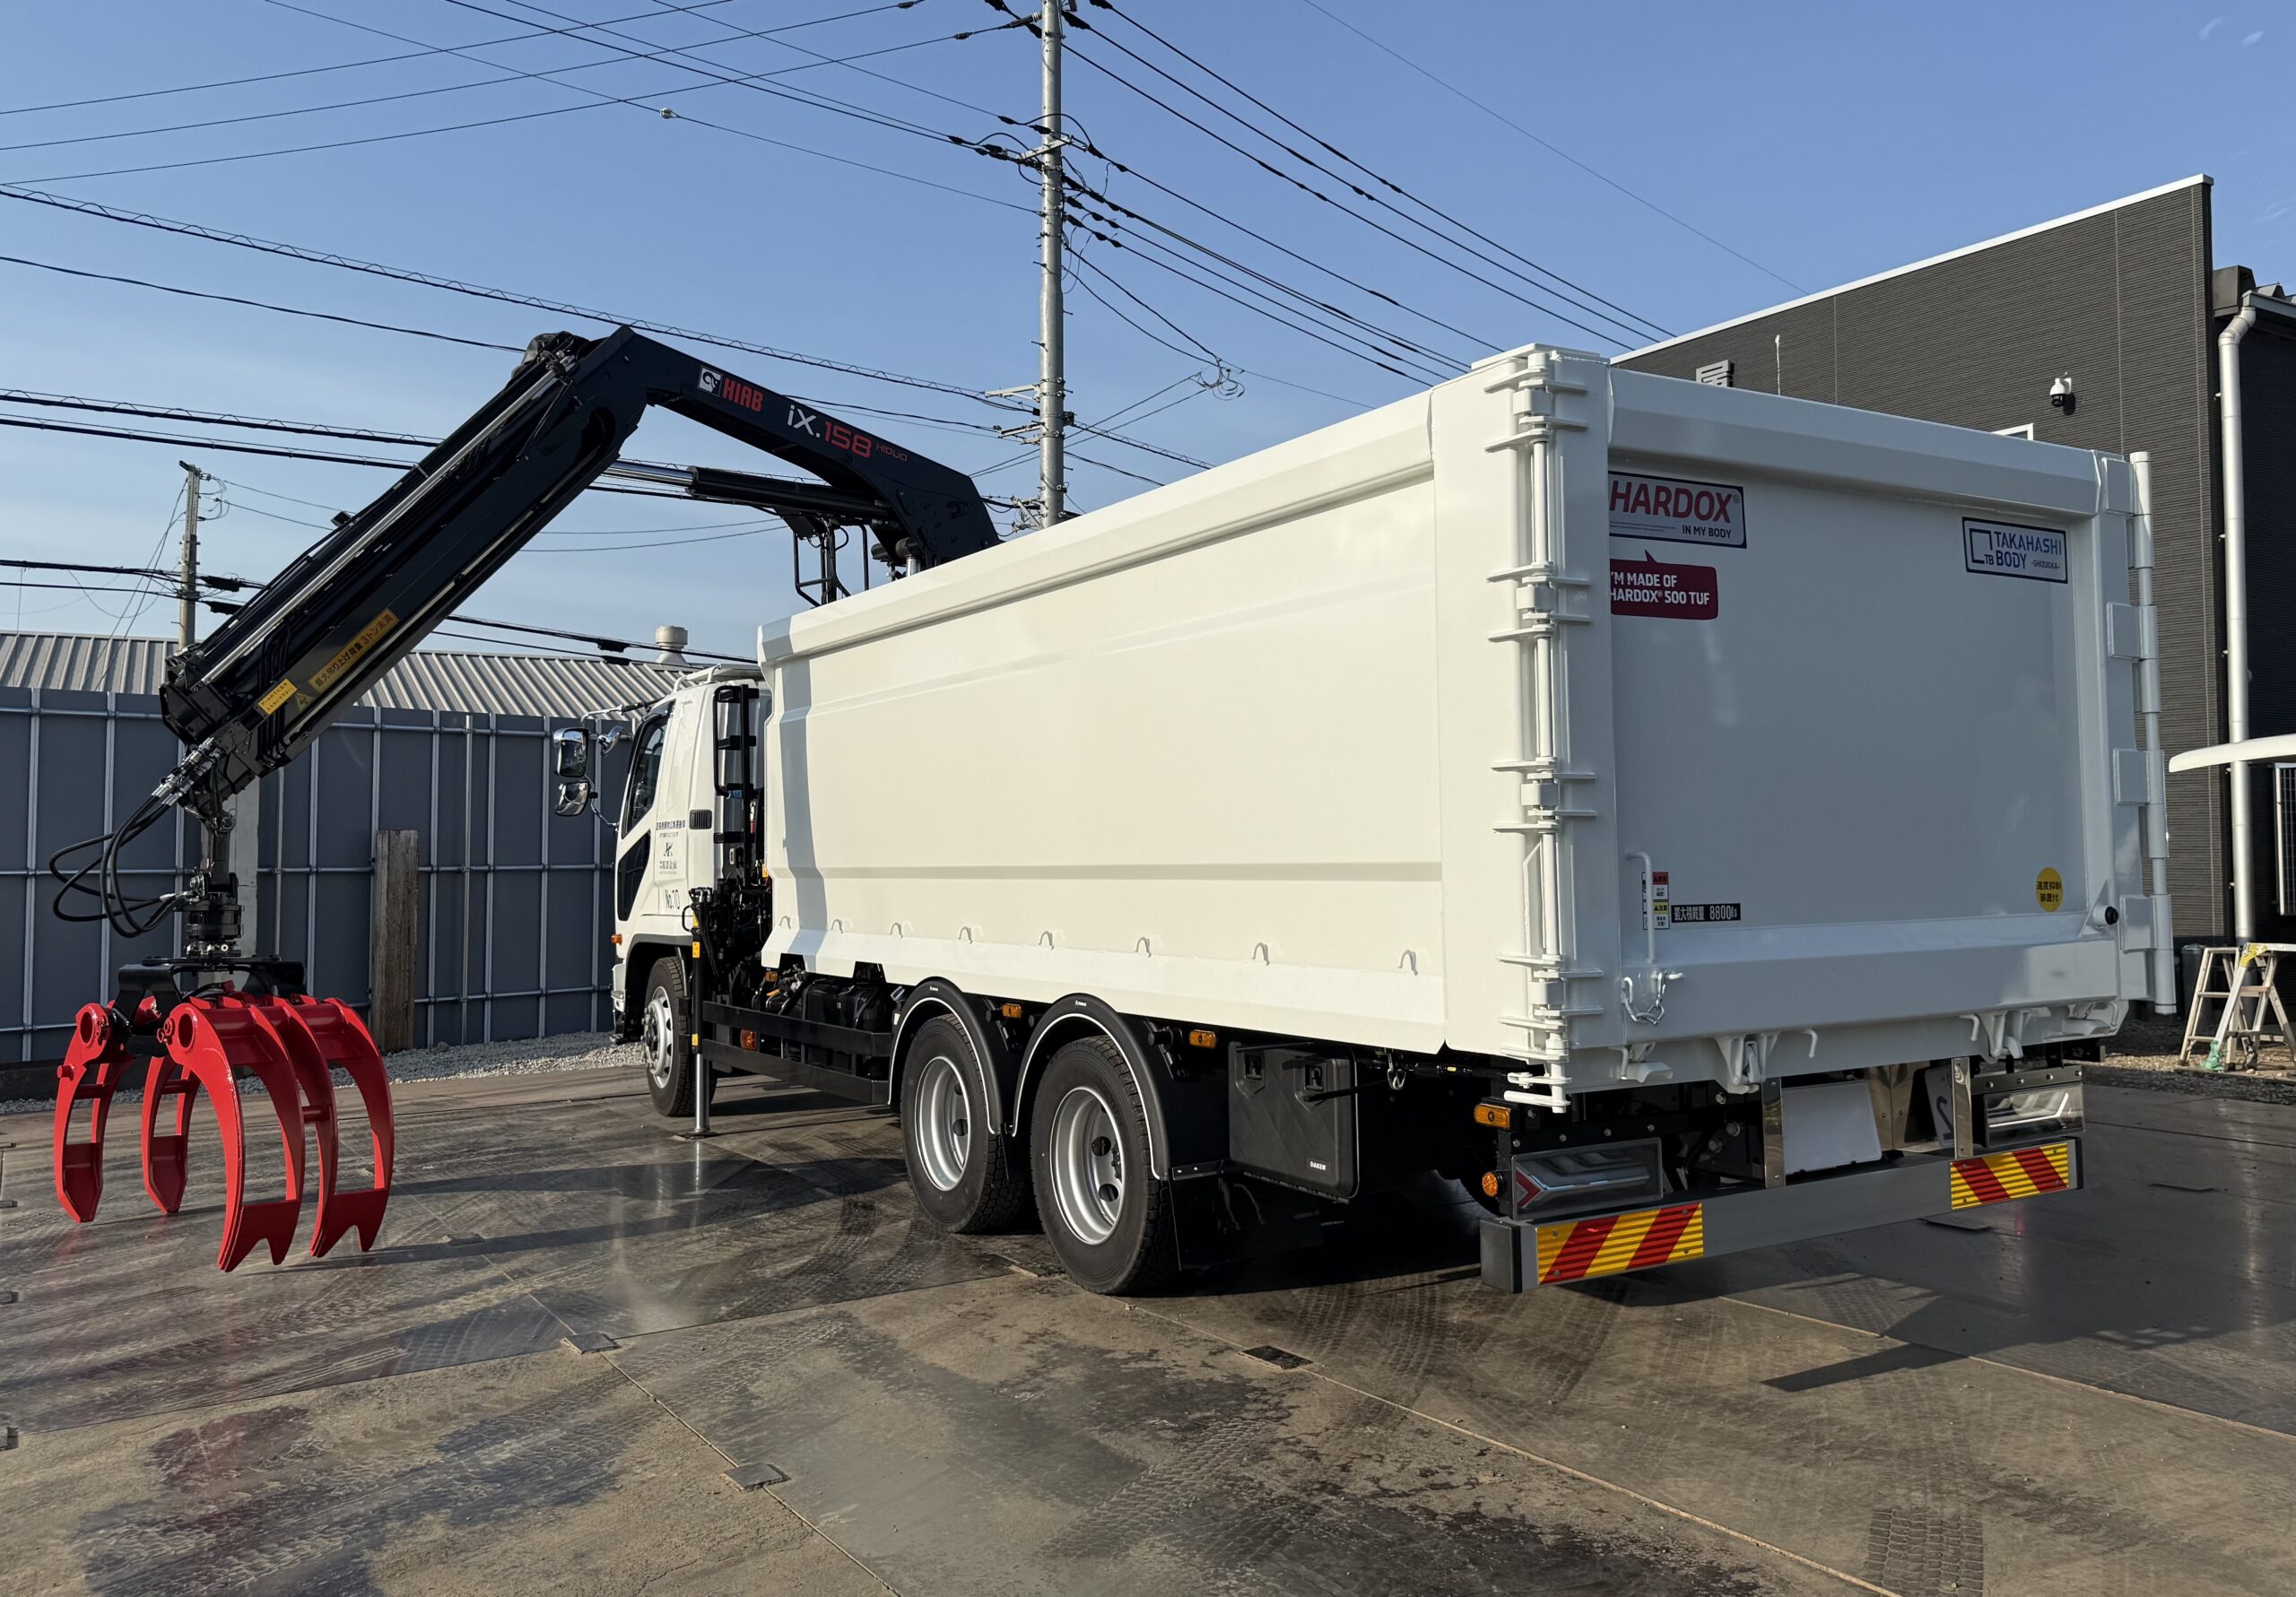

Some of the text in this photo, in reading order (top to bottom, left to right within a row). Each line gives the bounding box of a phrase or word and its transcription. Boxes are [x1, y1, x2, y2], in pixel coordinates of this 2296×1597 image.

[722, 378, 764, 412] HIAB
[1682, 524, 1692, 535] IN
[1692, 525, 1707, 537] MY
[1708, 527, 1732, 539] BODY
[1994, 530, 2062, 556] TAKAHASHI
[1995, 550, 2027, 569] BODY
[1611, 571, 1677, 588] 'M MADE OF
[1664, 590, 1687, 604] 500
[1688, 592, 1710, 605] TUF
[1674, 906, 1706, 922] 最大積載量
[1309, 1160, 1327, 1171] DAKEN
